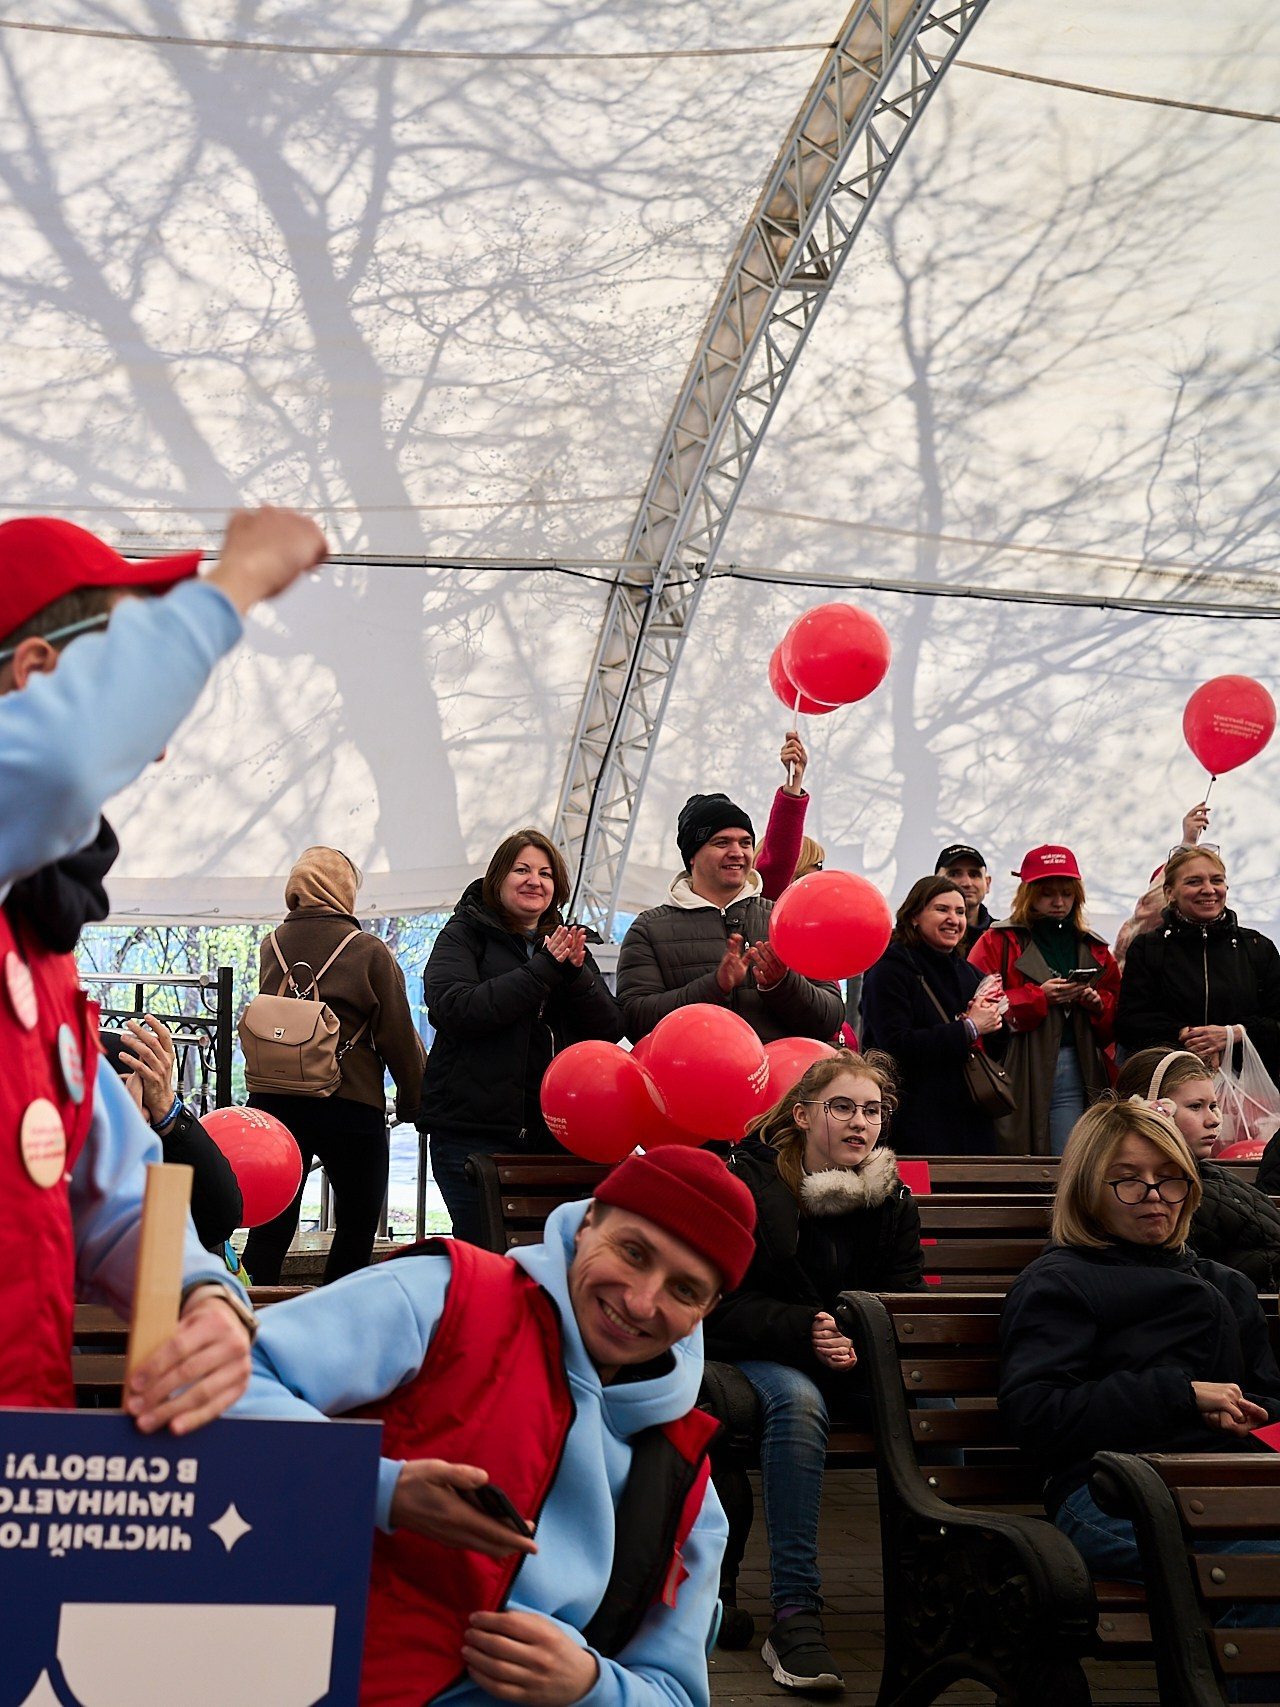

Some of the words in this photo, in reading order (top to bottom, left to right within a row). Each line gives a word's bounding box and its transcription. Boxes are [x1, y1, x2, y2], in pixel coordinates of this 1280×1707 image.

[5, 1453, 170, 1483] СУББОТУ!
[176, 1458, 198, 1484] В
[47, 1523, 192, 1557] ЧИСТЫЙ
